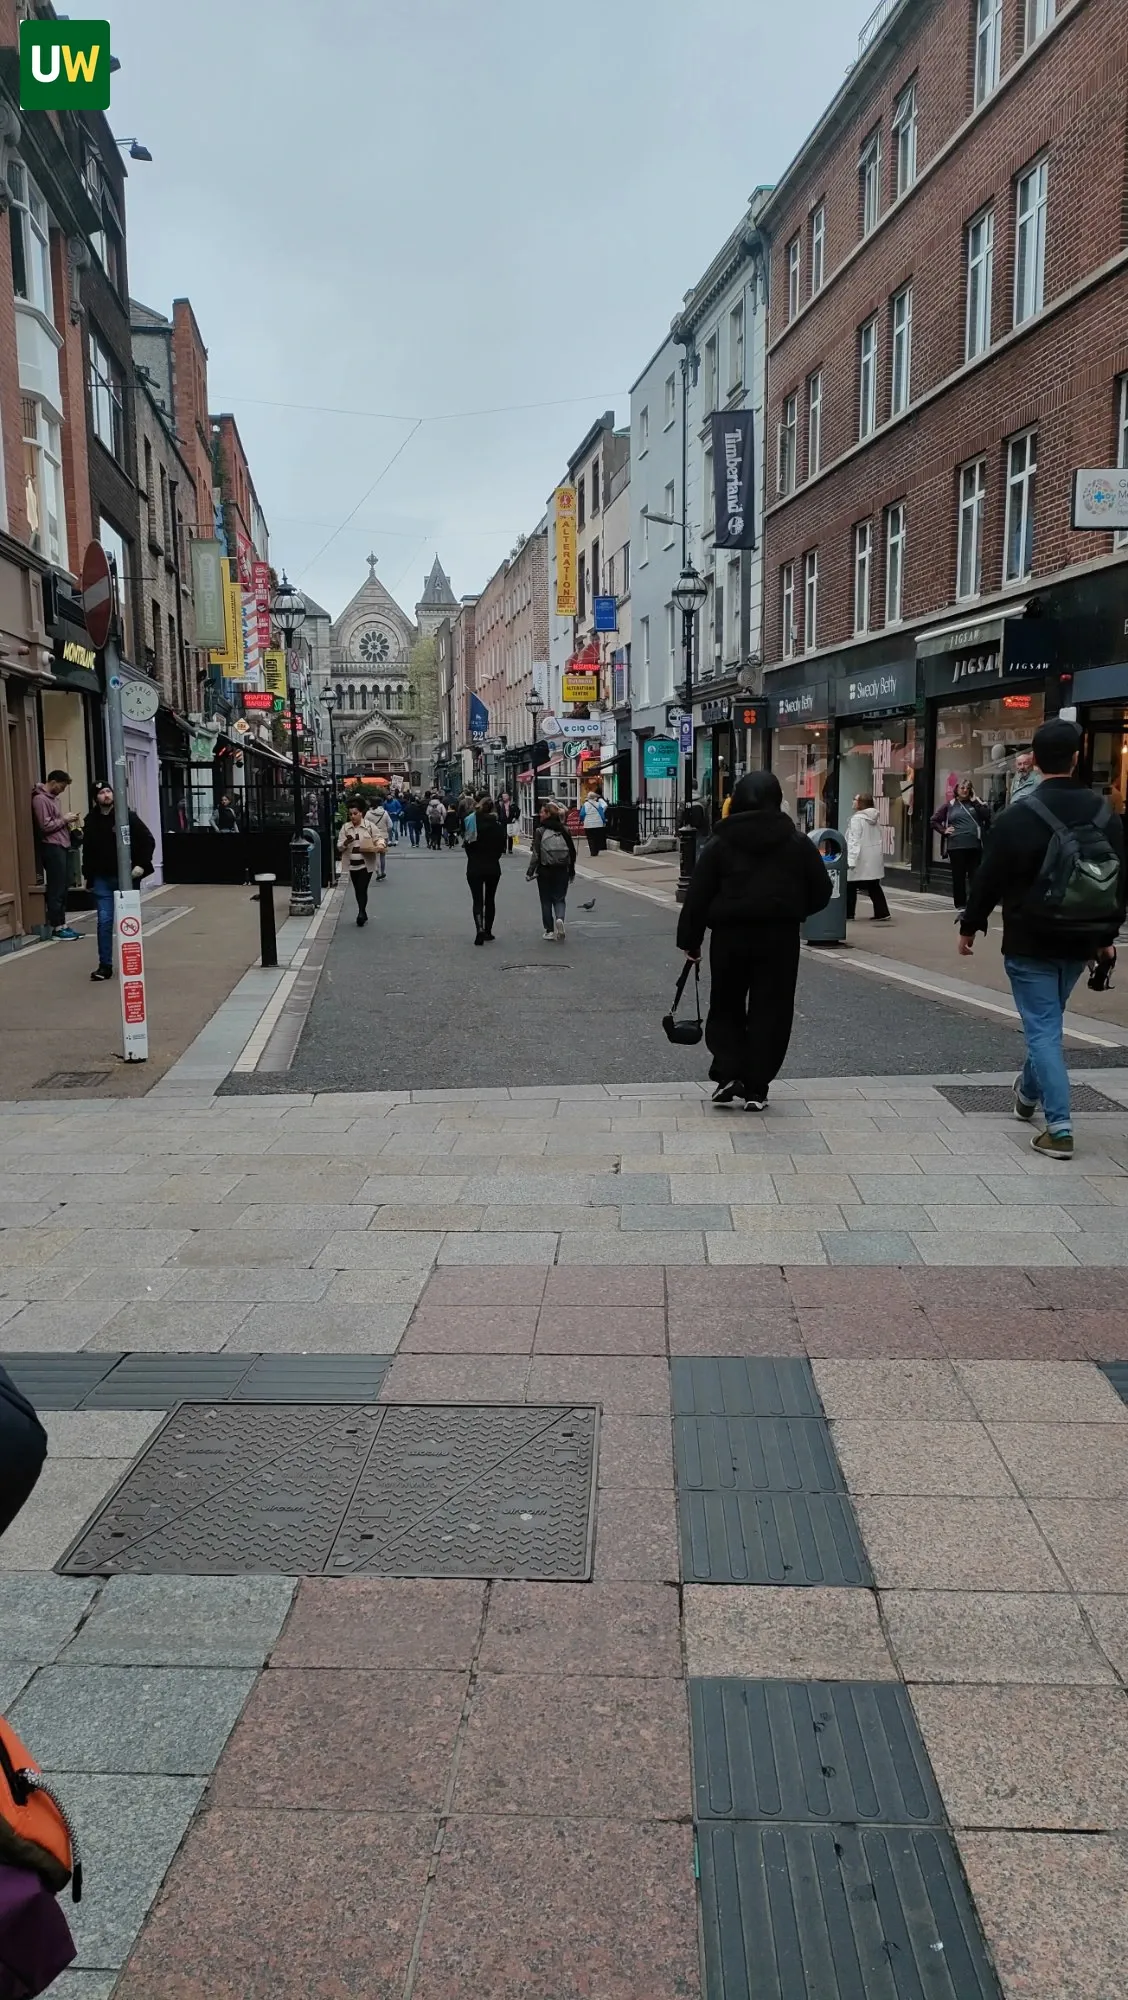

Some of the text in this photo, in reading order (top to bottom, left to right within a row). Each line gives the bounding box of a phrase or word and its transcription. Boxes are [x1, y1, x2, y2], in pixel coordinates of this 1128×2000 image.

[725, 428, 744, 514] Timberland
[1119, 479, 1128, 488] G
[562, 520, 571, 596] ALTERATION
[949, 629, 981, 649] JIGSAW
[1010, 662, 1050, 671] JIGSAW
[265, 659, 280, 690] GOTHAM
[125, 685, 151, 697] ASTRID
[857, 675, 897, 700] Sweaty Betty
[243, 693, 273, 701] GRAFTON
[784, 694, 814, 716] Sweaty Betty
[128, 707, 152, 717] MIYU
[260, 1503, 305, 1512] eircom
[502, 1507, 548, 1516] eircom
